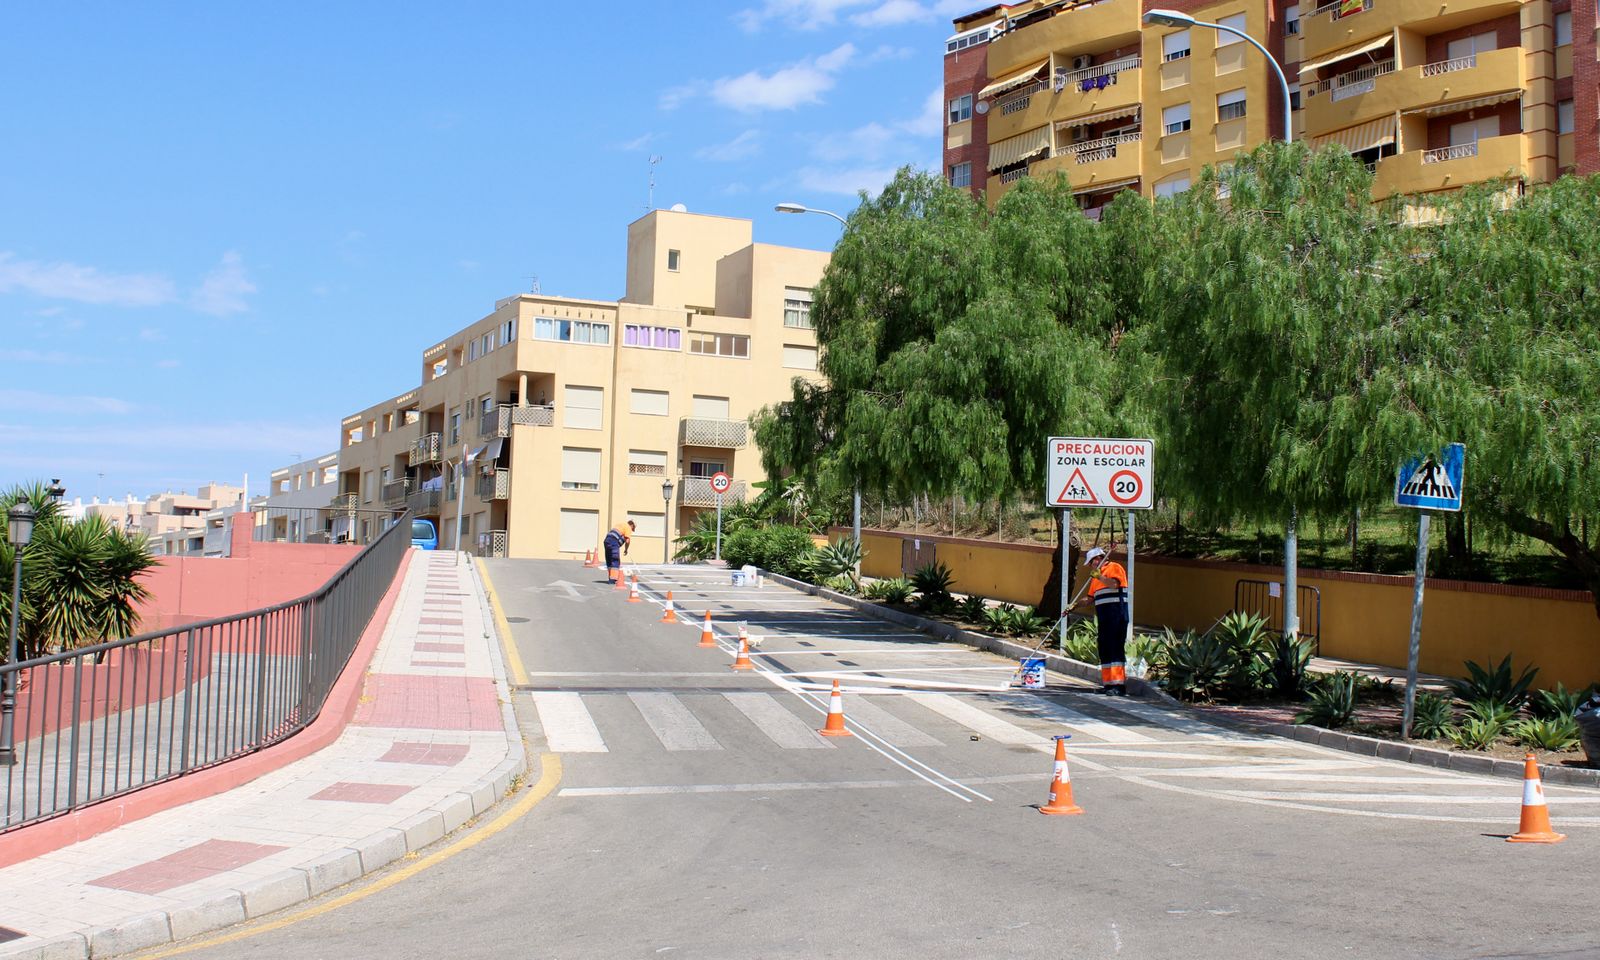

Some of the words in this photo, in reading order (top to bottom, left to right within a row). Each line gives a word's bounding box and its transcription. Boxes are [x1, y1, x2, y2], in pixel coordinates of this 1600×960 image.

[1057, 443, 1144, 455] PRECAUCION
[1057, 457, 1087, 465] ZONA
[1094, 458, 1145, 466] ESCOLAR
[715, 478, 726, 486] 20
[1116, 482, 1135, 493] 20
